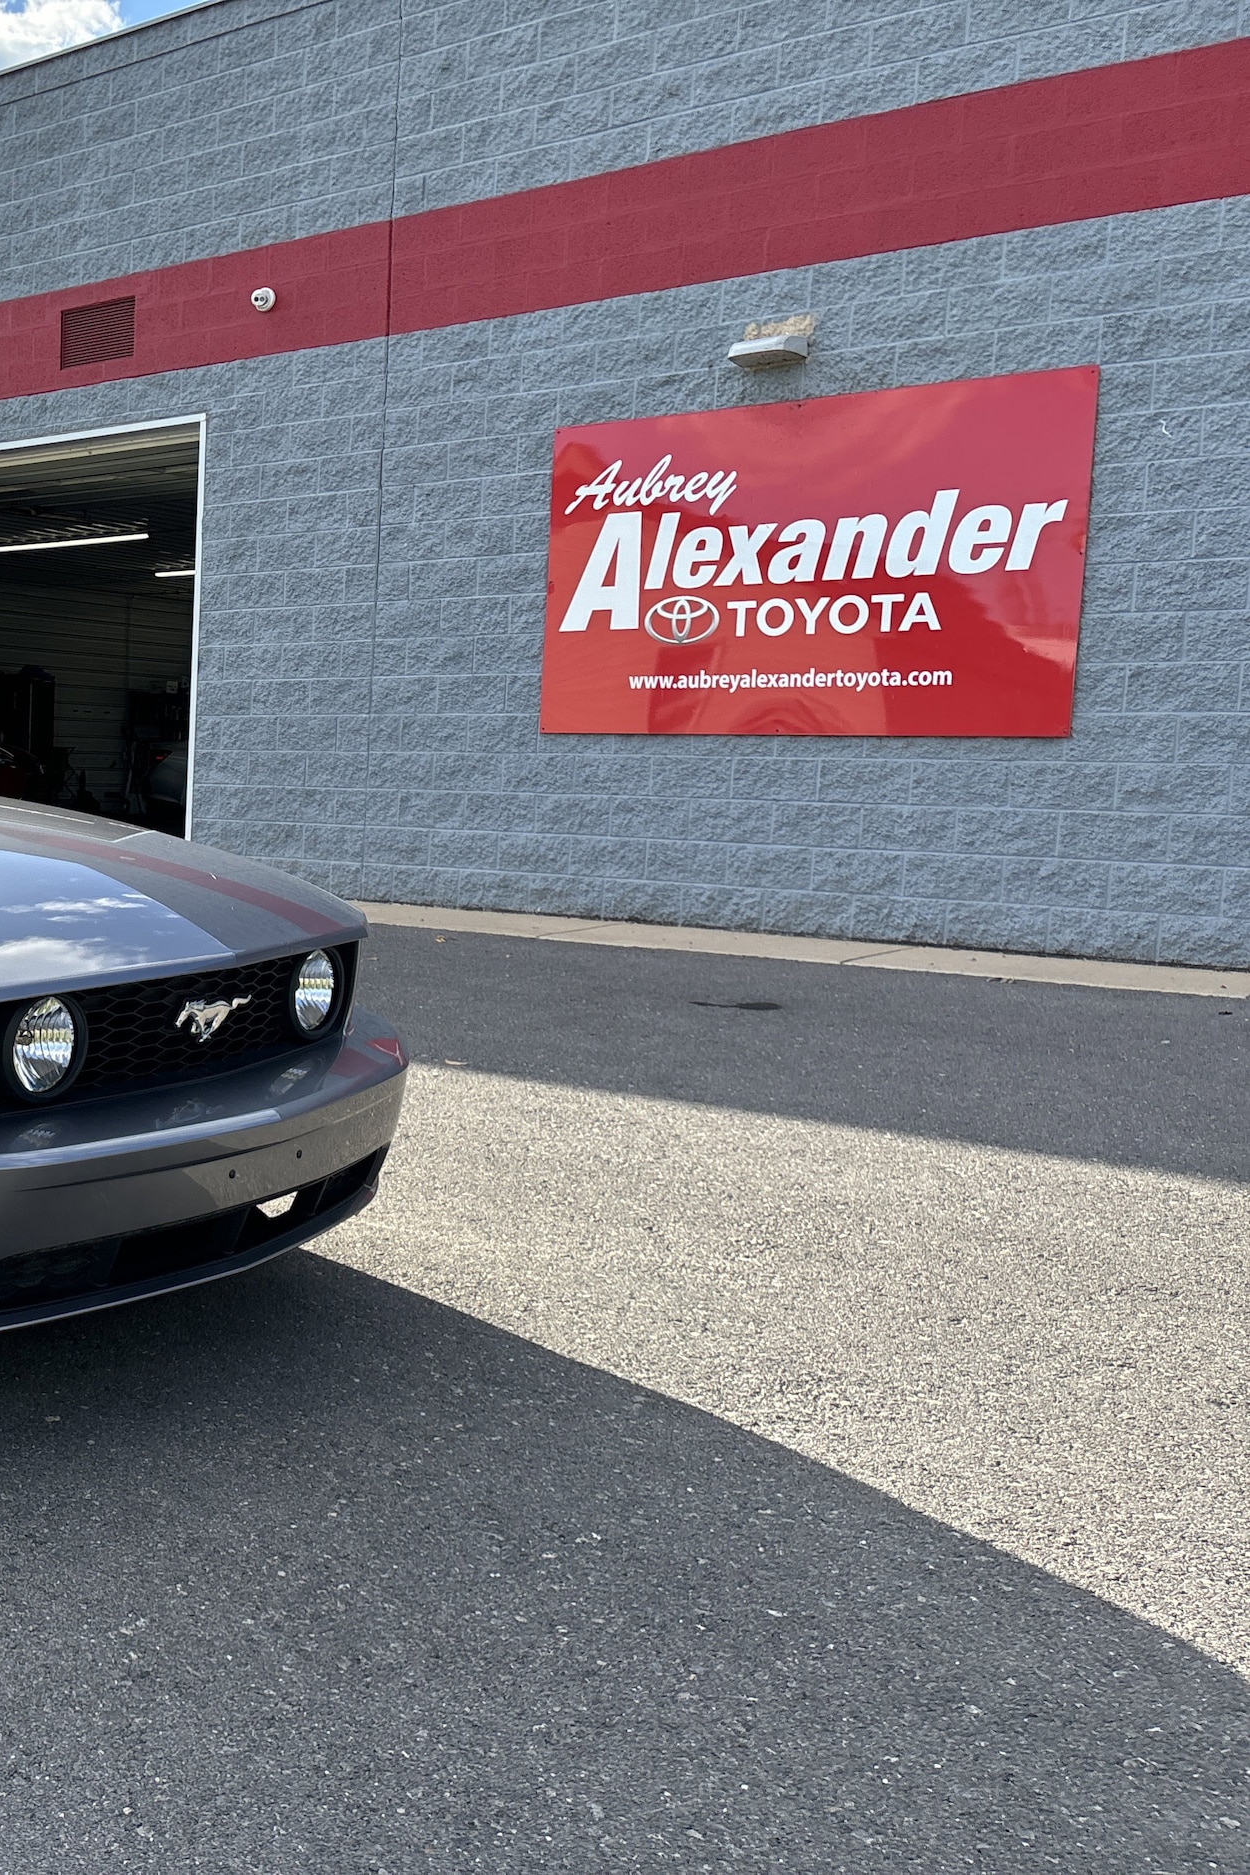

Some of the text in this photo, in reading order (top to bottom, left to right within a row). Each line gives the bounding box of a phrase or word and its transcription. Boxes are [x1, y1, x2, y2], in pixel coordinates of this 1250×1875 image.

[564, 453, 738, 515] Aubrey
[558, 488, 1069, 633] Alexander
[727, 592, 942, 638] TOYOTA
[628, 668, 953, 693] www.aubreyalexandertoyota.com
